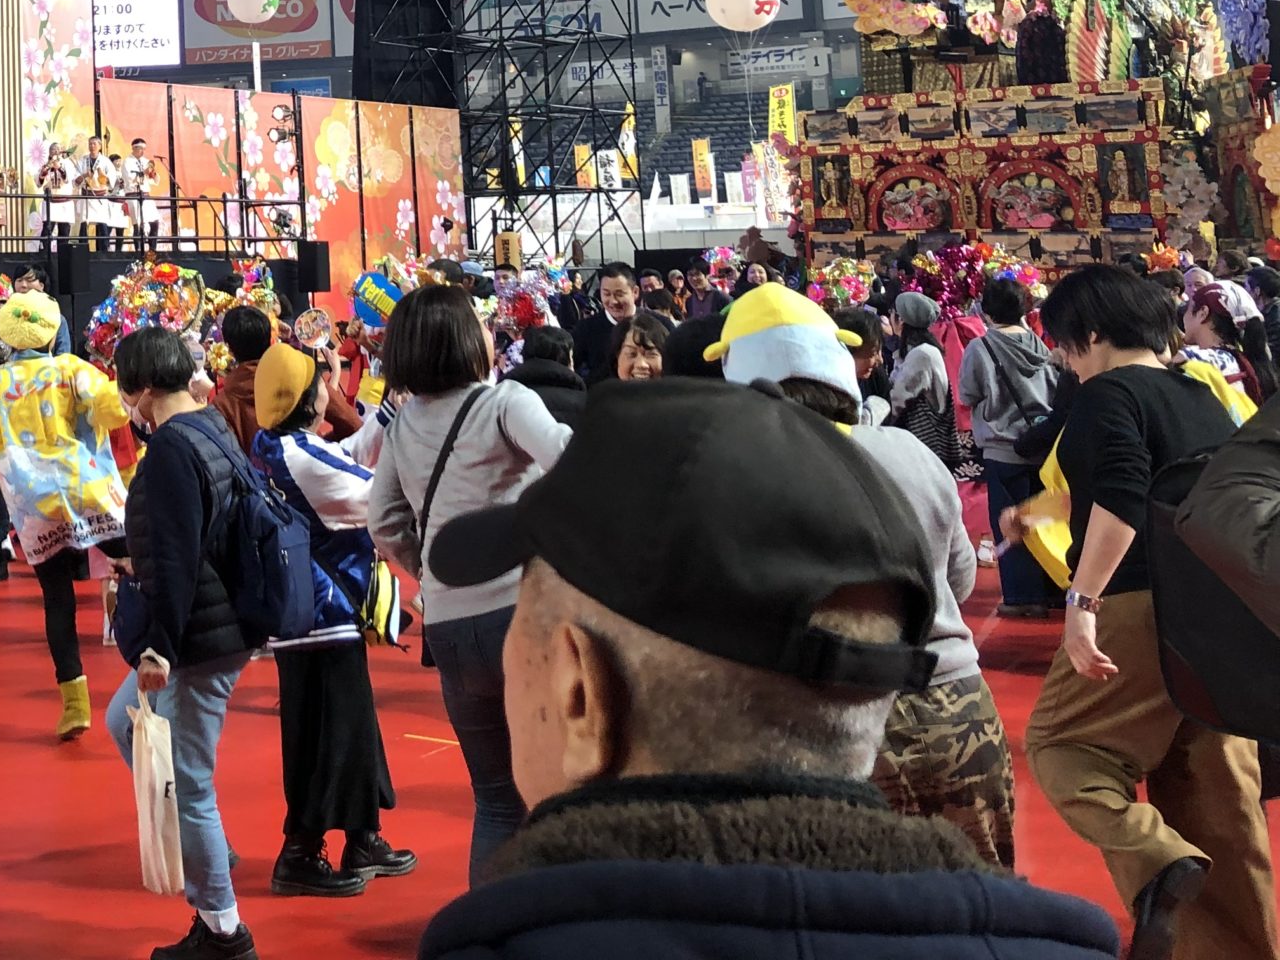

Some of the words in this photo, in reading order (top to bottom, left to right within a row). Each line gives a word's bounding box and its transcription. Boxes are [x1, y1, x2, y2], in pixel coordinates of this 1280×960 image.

[195, 47, 273, 62] バンダイナコ
